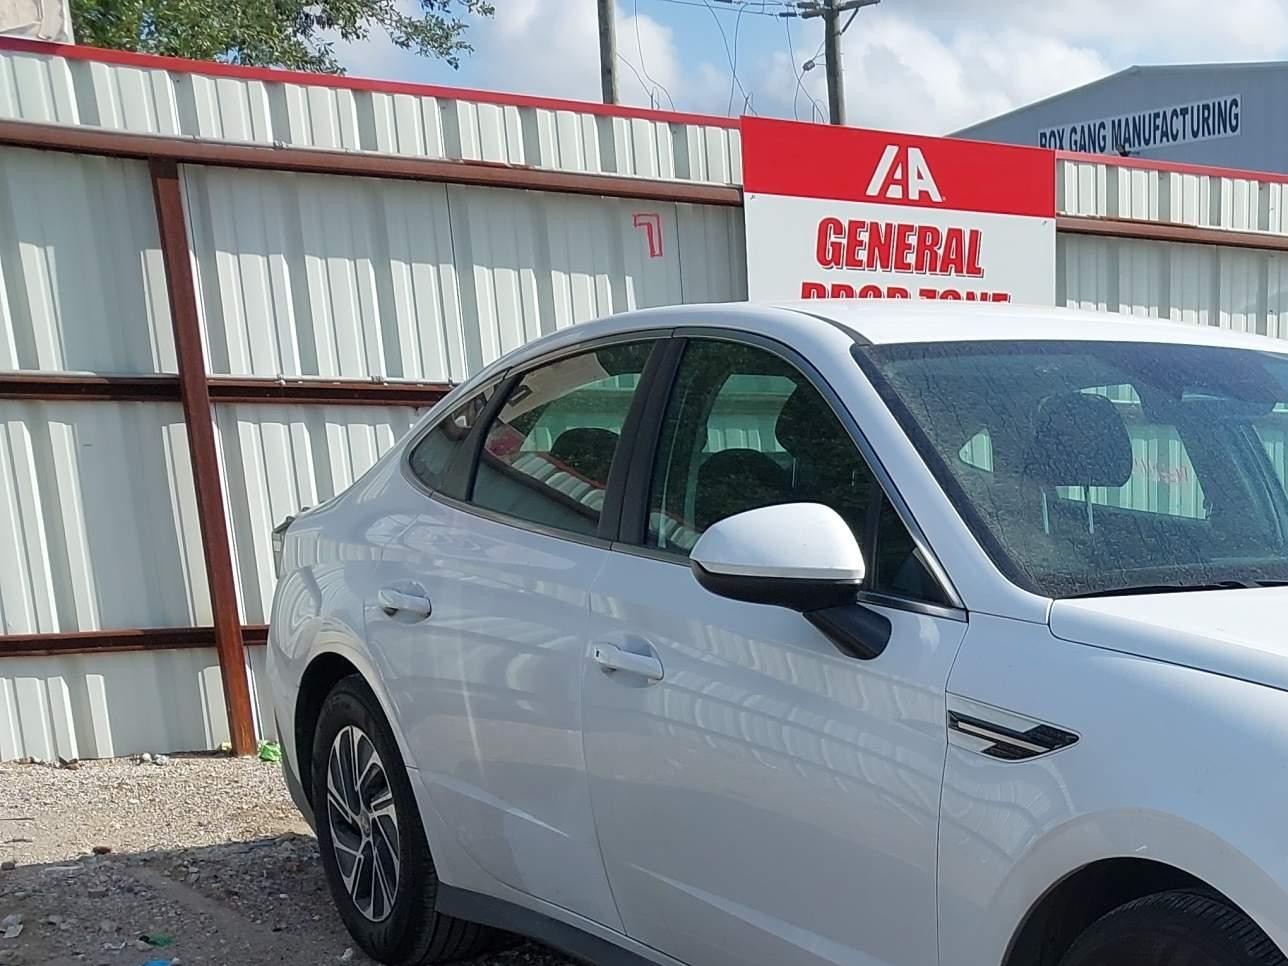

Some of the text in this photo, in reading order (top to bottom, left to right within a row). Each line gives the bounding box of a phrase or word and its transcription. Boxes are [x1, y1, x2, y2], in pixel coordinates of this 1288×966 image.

[1069, 121, 1107, 153] GANG
[1111, 98, 1239, 151] MANUFACTURING
[815, 216, 984, 279] GENERAL
